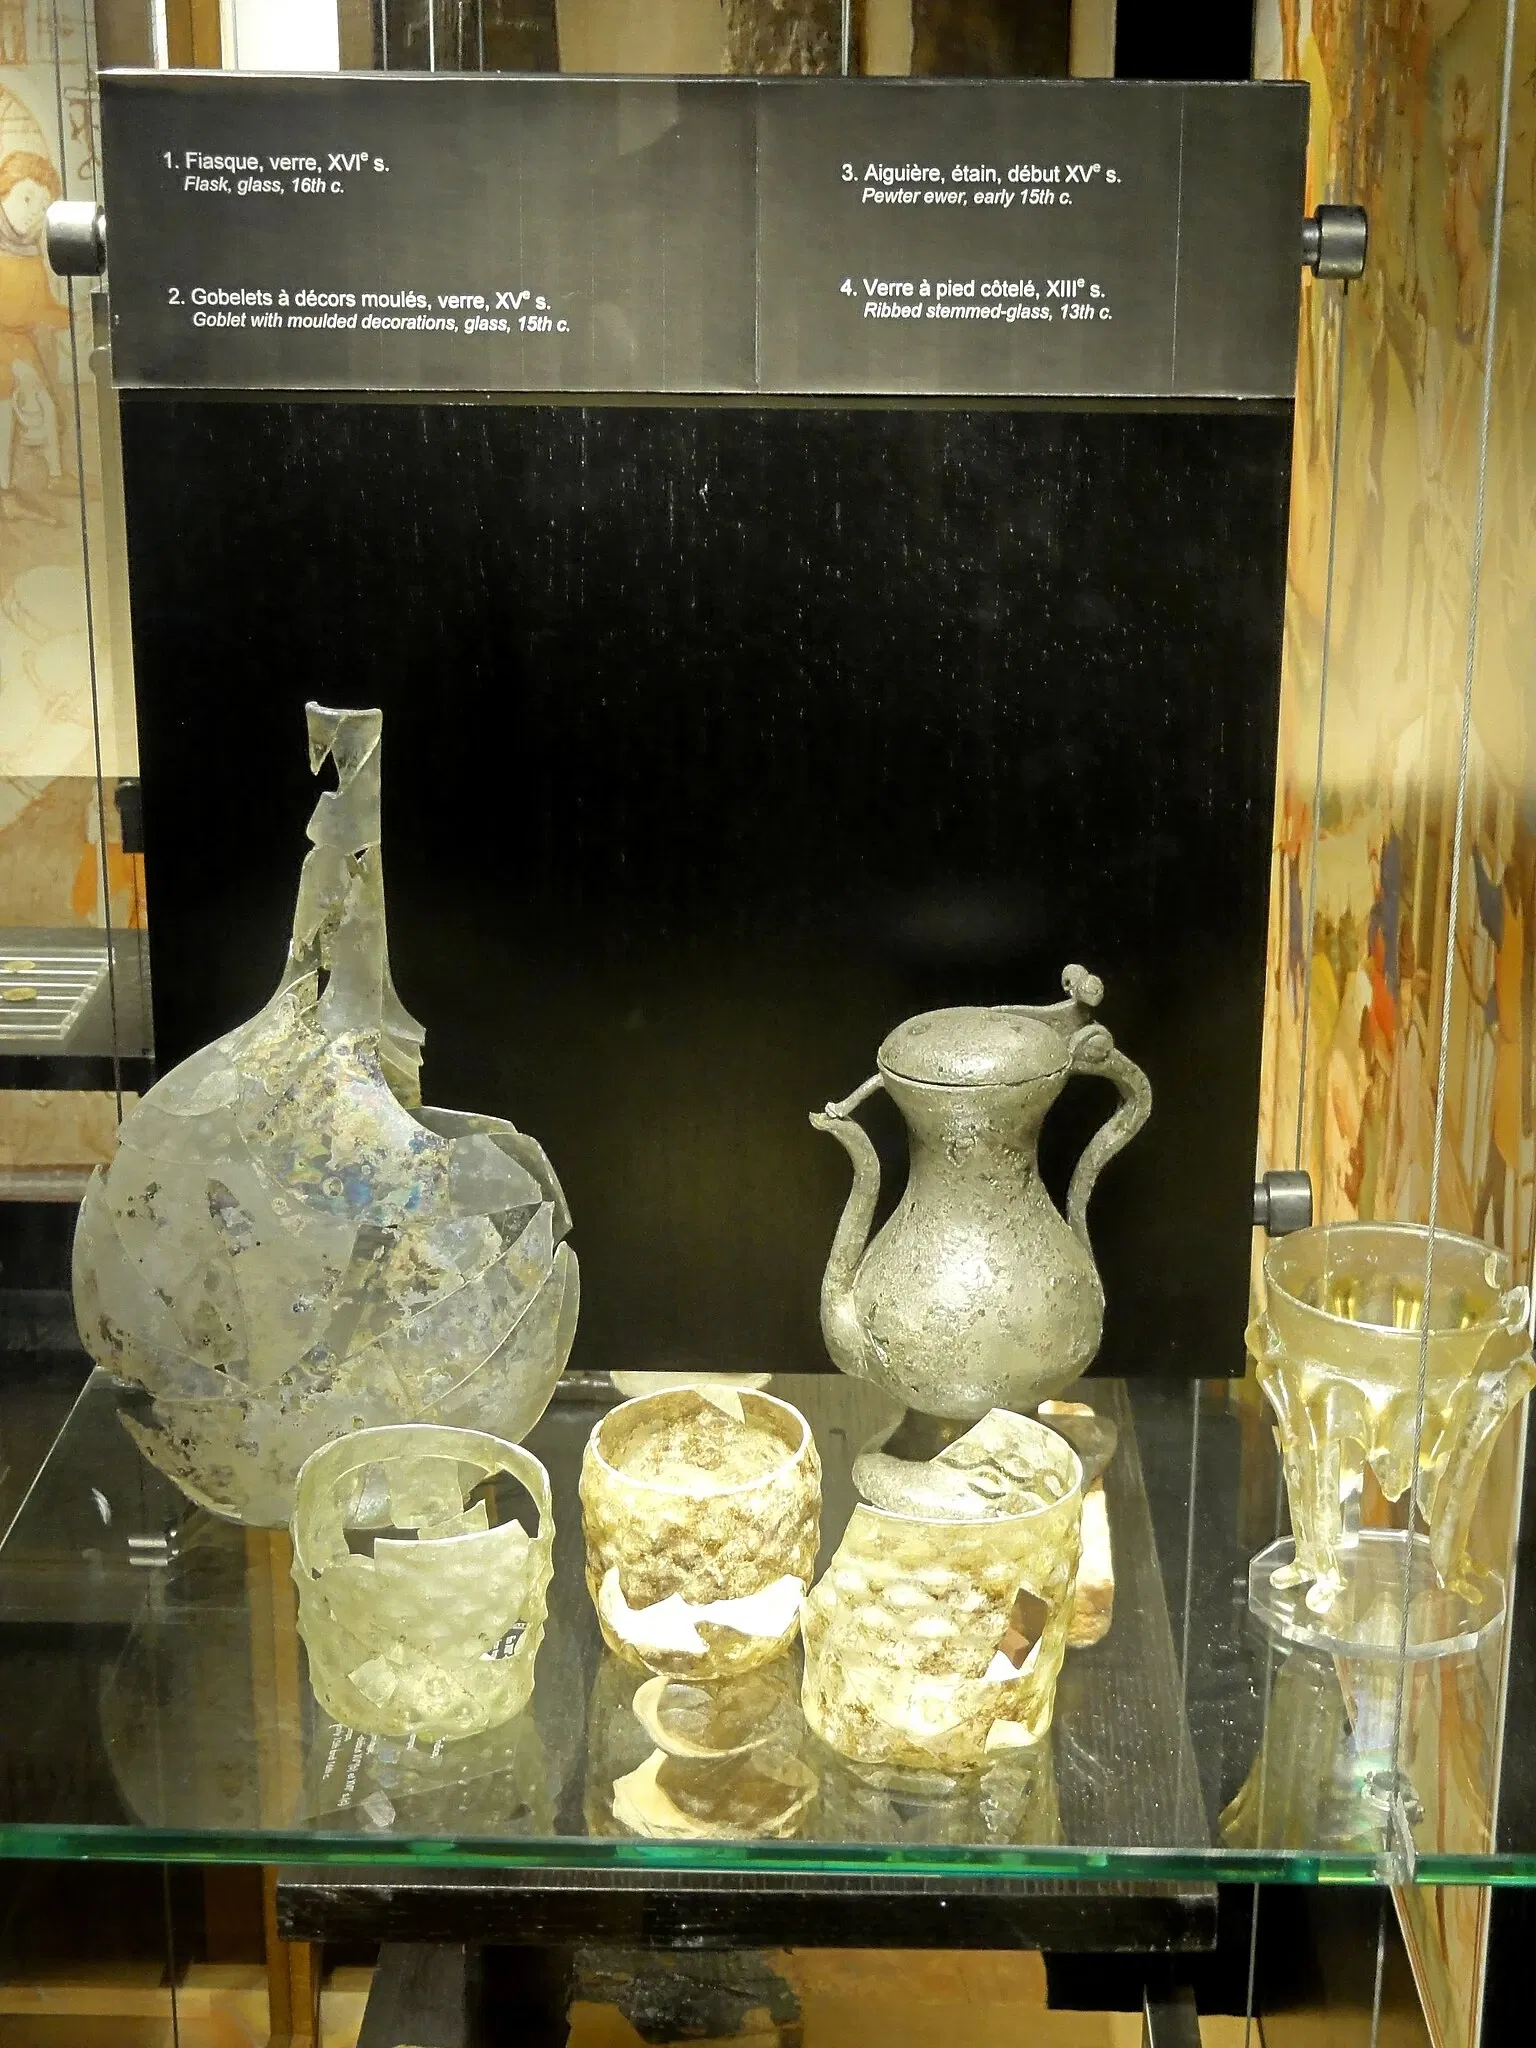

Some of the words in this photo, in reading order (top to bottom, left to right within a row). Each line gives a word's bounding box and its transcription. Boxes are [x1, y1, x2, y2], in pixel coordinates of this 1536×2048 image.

[162, 151, 180, 169] 1.
[185, 152, 264, 175] Fiasque,
[268, 156, 322, 174] verre,
[373, 157, 390, 173] s.
[841, 163, 859, 182] 3.
[863, 163, 946, 186] Aiguière,
[951, 163, 1002, 186] étain,
[1007, 164, 1061, 184] début
[1105, 168, 1122, 184] s.
[183, 175, 232, 195] Flask,
[236, 176, 285, 196] glass,
[291, 176, 327, 194] 16th
[330, 180, 345, 194] c.
[861, 187, 922, 204] Pewter
[923, 190, 968, 207] ewer,
[973, 188, 1016, 209] early
[1020, 188, 1055, 205] 15th
[1058, 191, 1073, 205] c.
[167, 287, 186, 305] 2.
[190, 287, 274, 307] Gobelets
[277, 288, 290, 307] à
[294, 288, 357, 308] décors
[361, 290, 432, 311] moulés,
[437, 295, 490, 313] verre,
[535, 295, 551, 311] s.
[839, 278, 858, 297] 4.
[862, 278, 914, 297] Verre
[918, 278, 931, 297] à
[936, 279, 976, 301] pied
[980, 279, 1040, 301] côtelé,
[1089, 283, 1106, 299] s.
[192, 311, 247, 328] Goblet
[250, 311, 283, 328] with
[286, 312, 358, 329] moulded
[360, 313, 459, 333] decorations,
[463, 314, 511, 335] glass,
[518, 315, 553, 332] 15th
[556, 319, 571, 333] c.
[863, 301, 923, 319] Ribbed
[925, 302, 1053, 323] stemmed-glass,
[1060, 303, 1095, 320] 13th
[1098, 306, 1113, 321] c.
